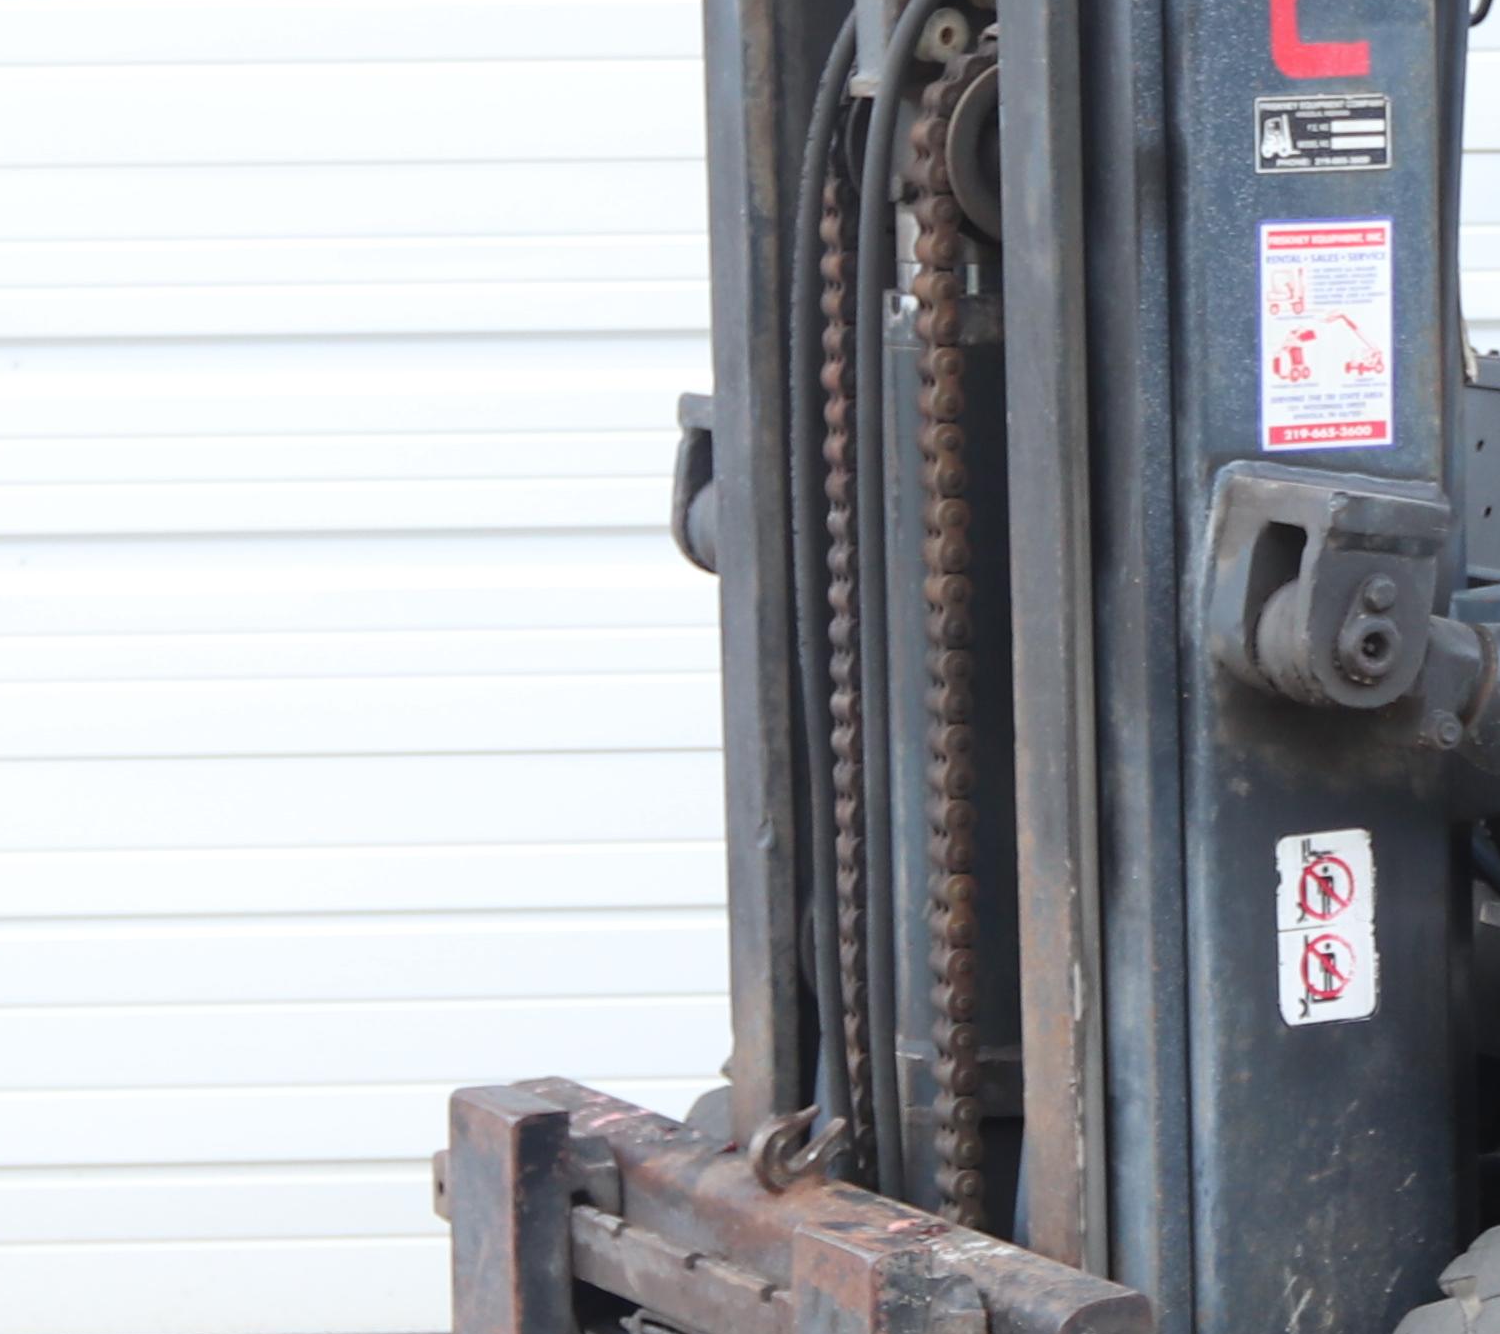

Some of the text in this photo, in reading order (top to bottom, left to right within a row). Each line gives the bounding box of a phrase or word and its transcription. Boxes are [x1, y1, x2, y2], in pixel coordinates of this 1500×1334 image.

[1267, 252, 1385, 264] RENTAL SALES SERVICE
[1283, 425, 1372, 441] 219-665-3600
